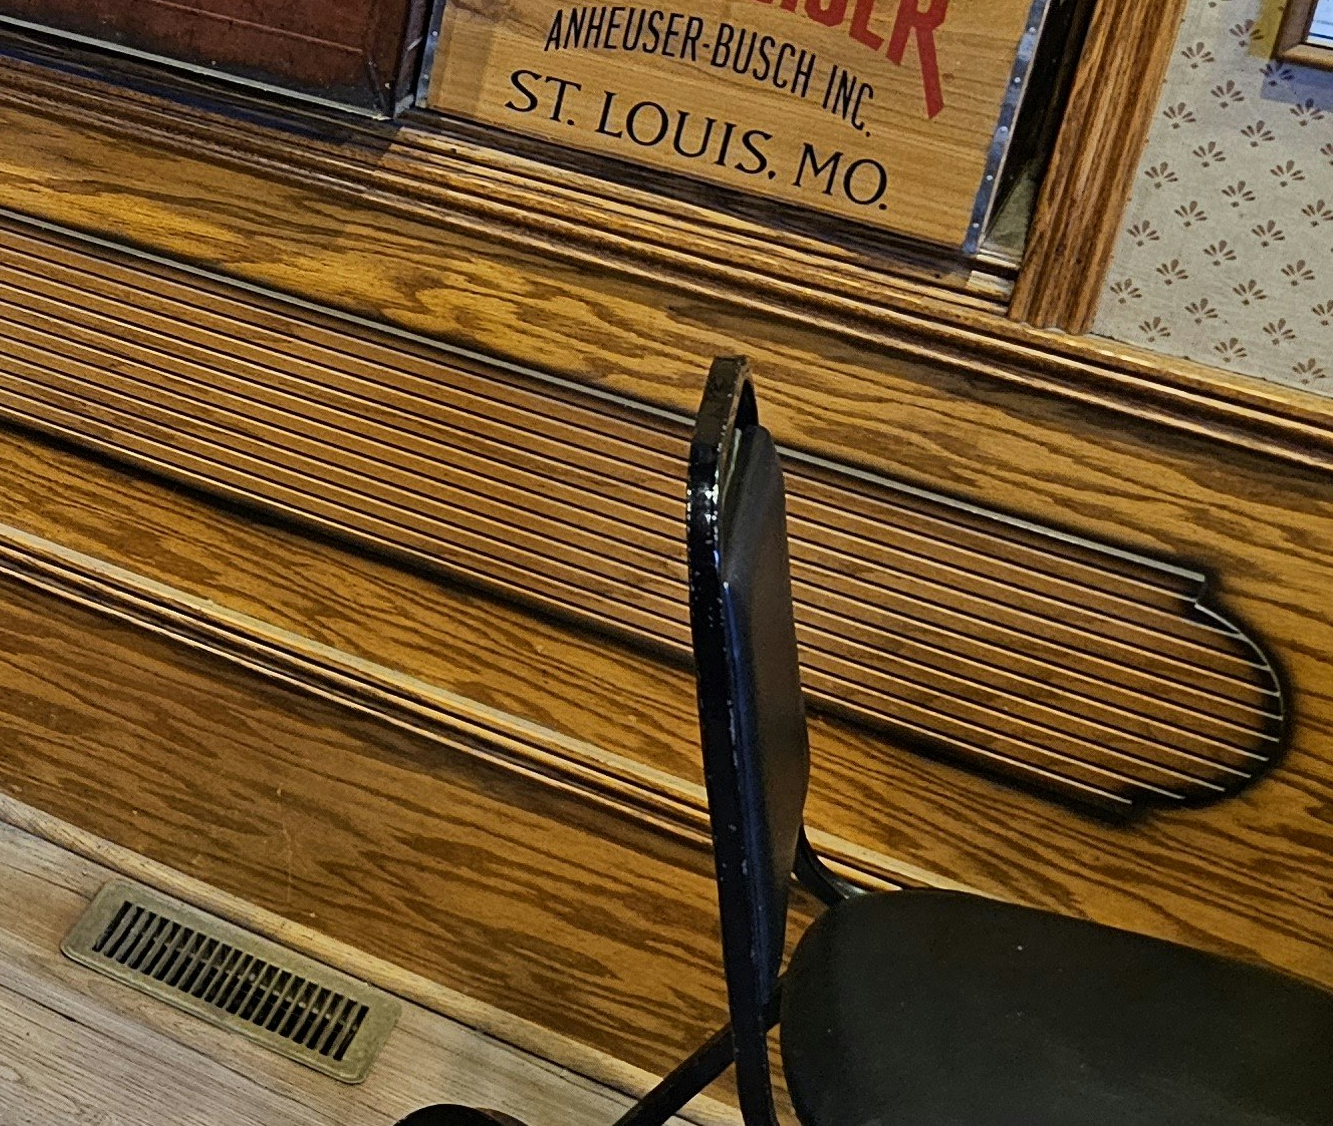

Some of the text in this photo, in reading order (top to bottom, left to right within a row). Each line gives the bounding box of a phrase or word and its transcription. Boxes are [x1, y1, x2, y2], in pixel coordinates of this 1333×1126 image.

[504, 68, 582, 127] ST.
[791, 142, 889, 211] MO.
[543, 5, 874, 137] ANHEUSER-BUSCH INC.
